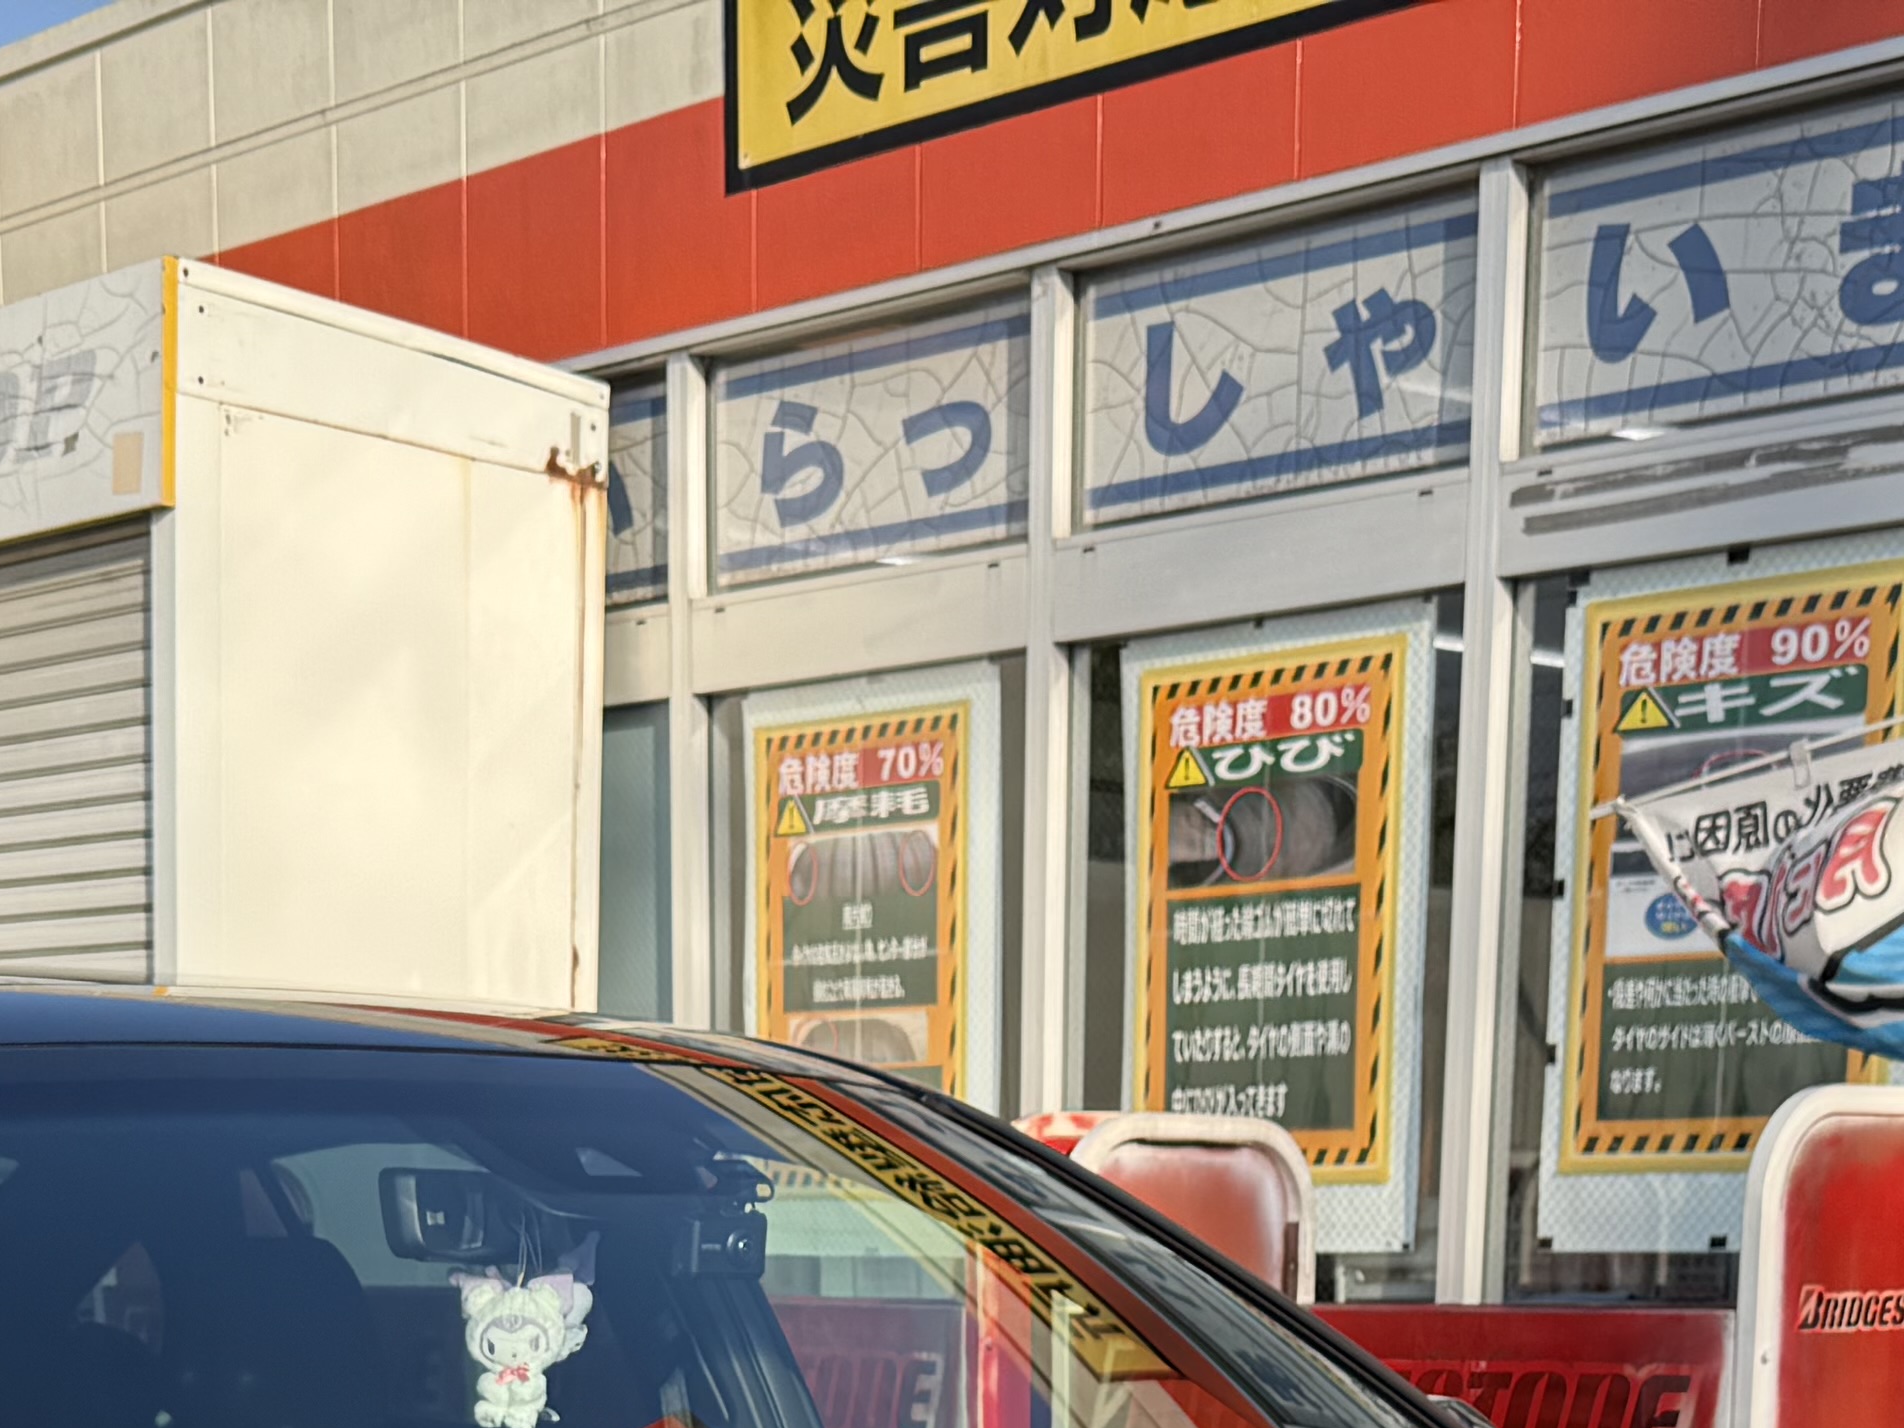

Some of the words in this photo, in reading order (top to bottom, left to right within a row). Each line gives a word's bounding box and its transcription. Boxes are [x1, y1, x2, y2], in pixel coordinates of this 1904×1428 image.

[1618, 633, 1740, 687] 危険度
[1770, 616, 1872, 665] 90%
[1169, 700, 1268, 748] 危険度
[1290, 684, 1371, 730] 80%
[1678, 666, 1859, 722] キズ
[779, 752, 860, 797] 危険度
[878, 742, 944, 781] 70%
[1213, 732, 1355, 782] ひび
